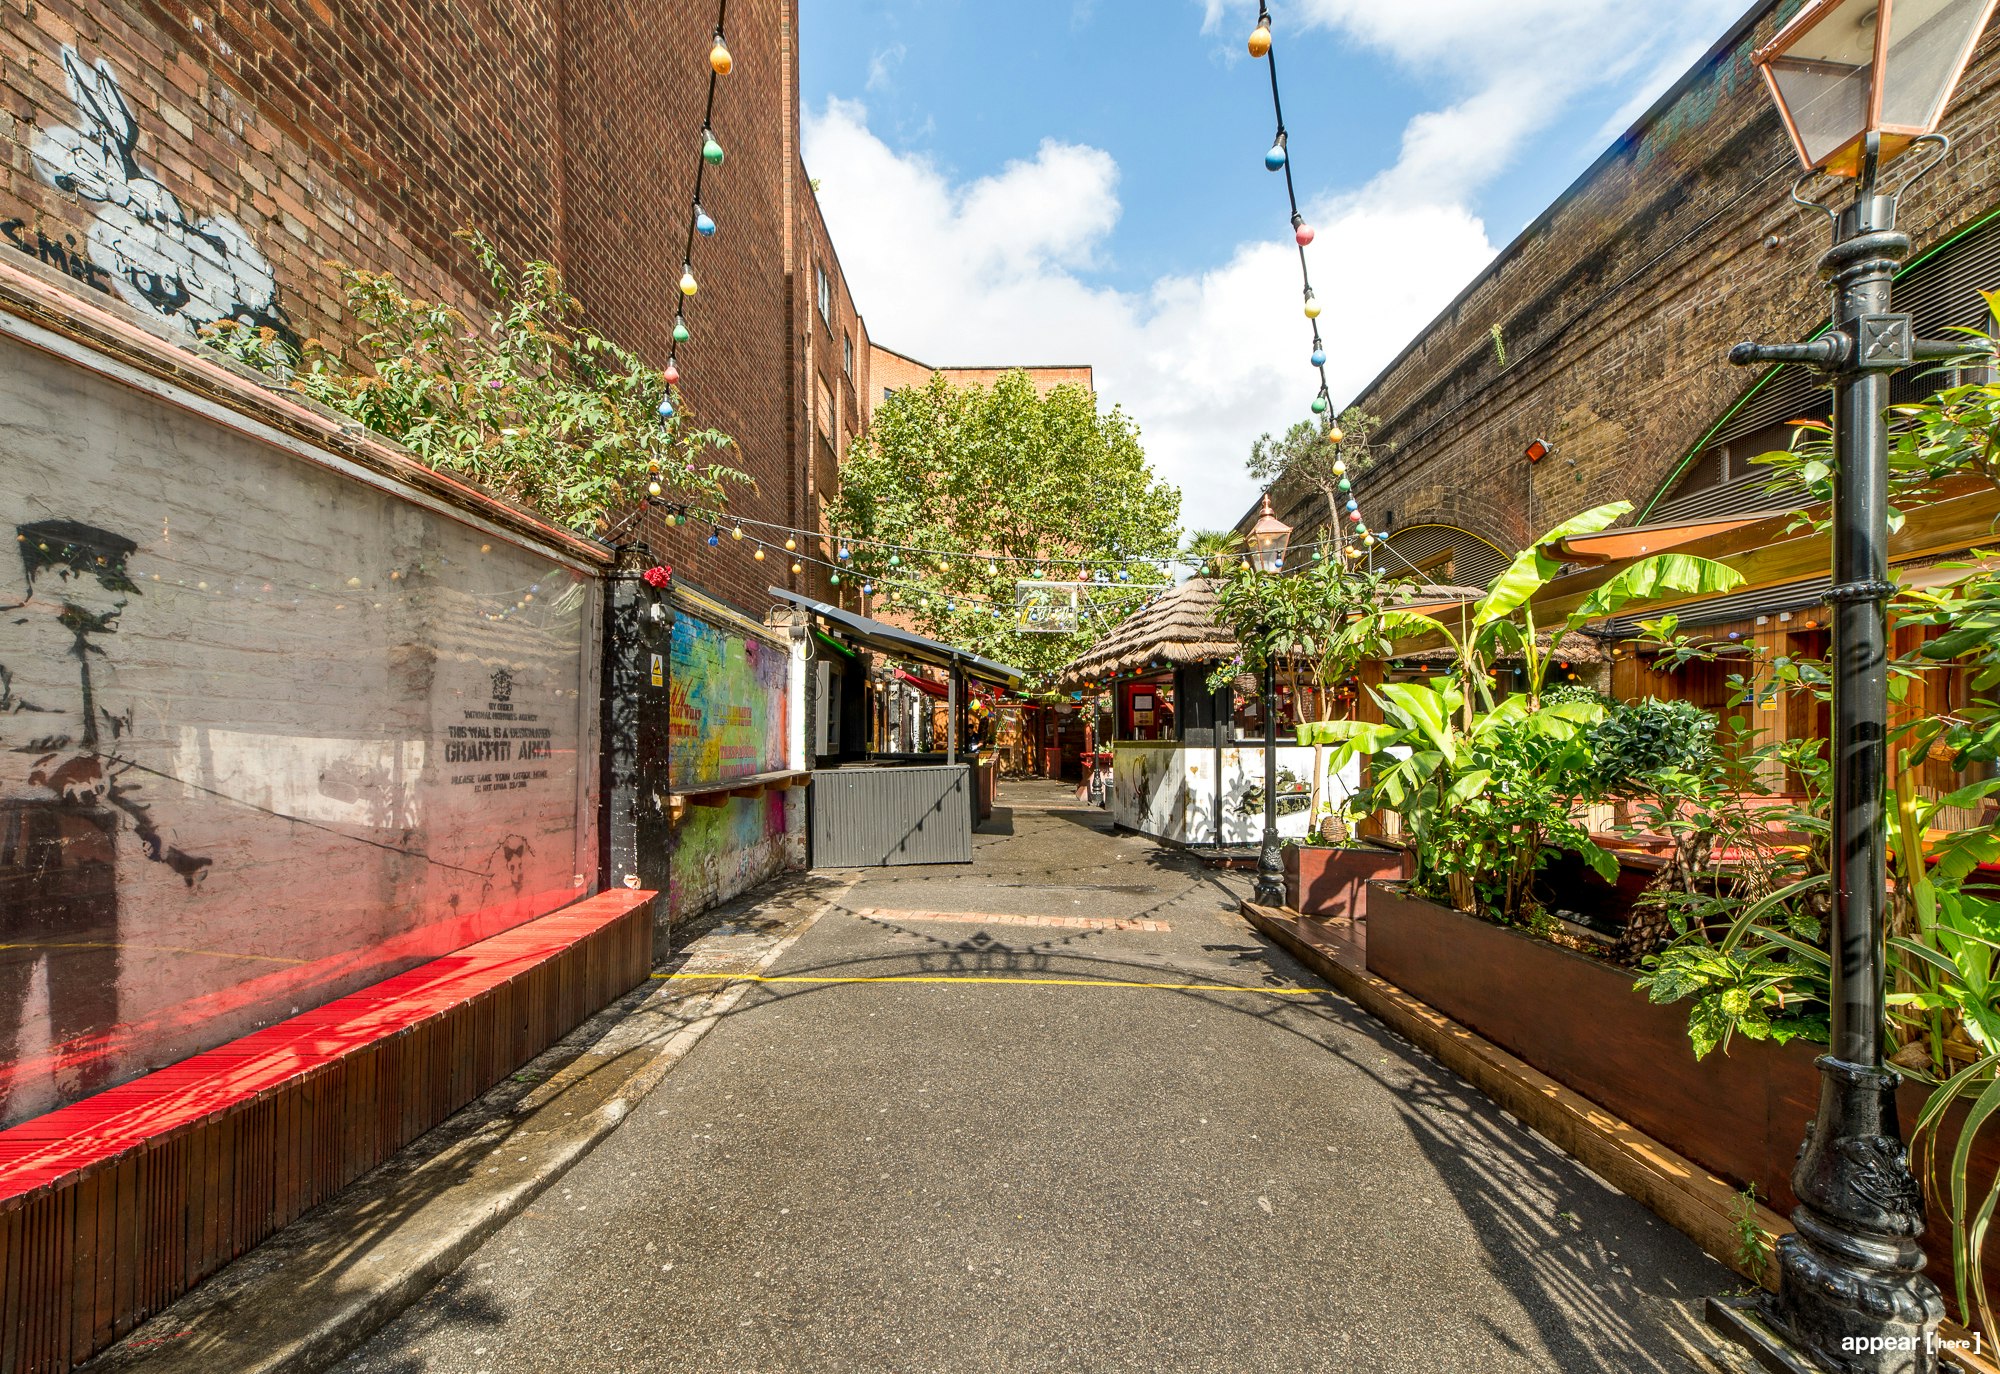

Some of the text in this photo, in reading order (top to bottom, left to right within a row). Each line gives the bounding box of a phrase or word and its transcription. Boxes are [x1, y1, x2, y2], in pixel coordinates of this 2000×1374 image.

[498, 703, 513, 711] ORDER
[448, 726, 551, 739] THIS WALL IS A DESIGNATED
[445, 740, 552, 763] GRAFFITI AREA
[451, 774, 475, 785] PLEASE
[477, 773, 492, 783] TAKE
[494, 772, 511, 782] YOUR
